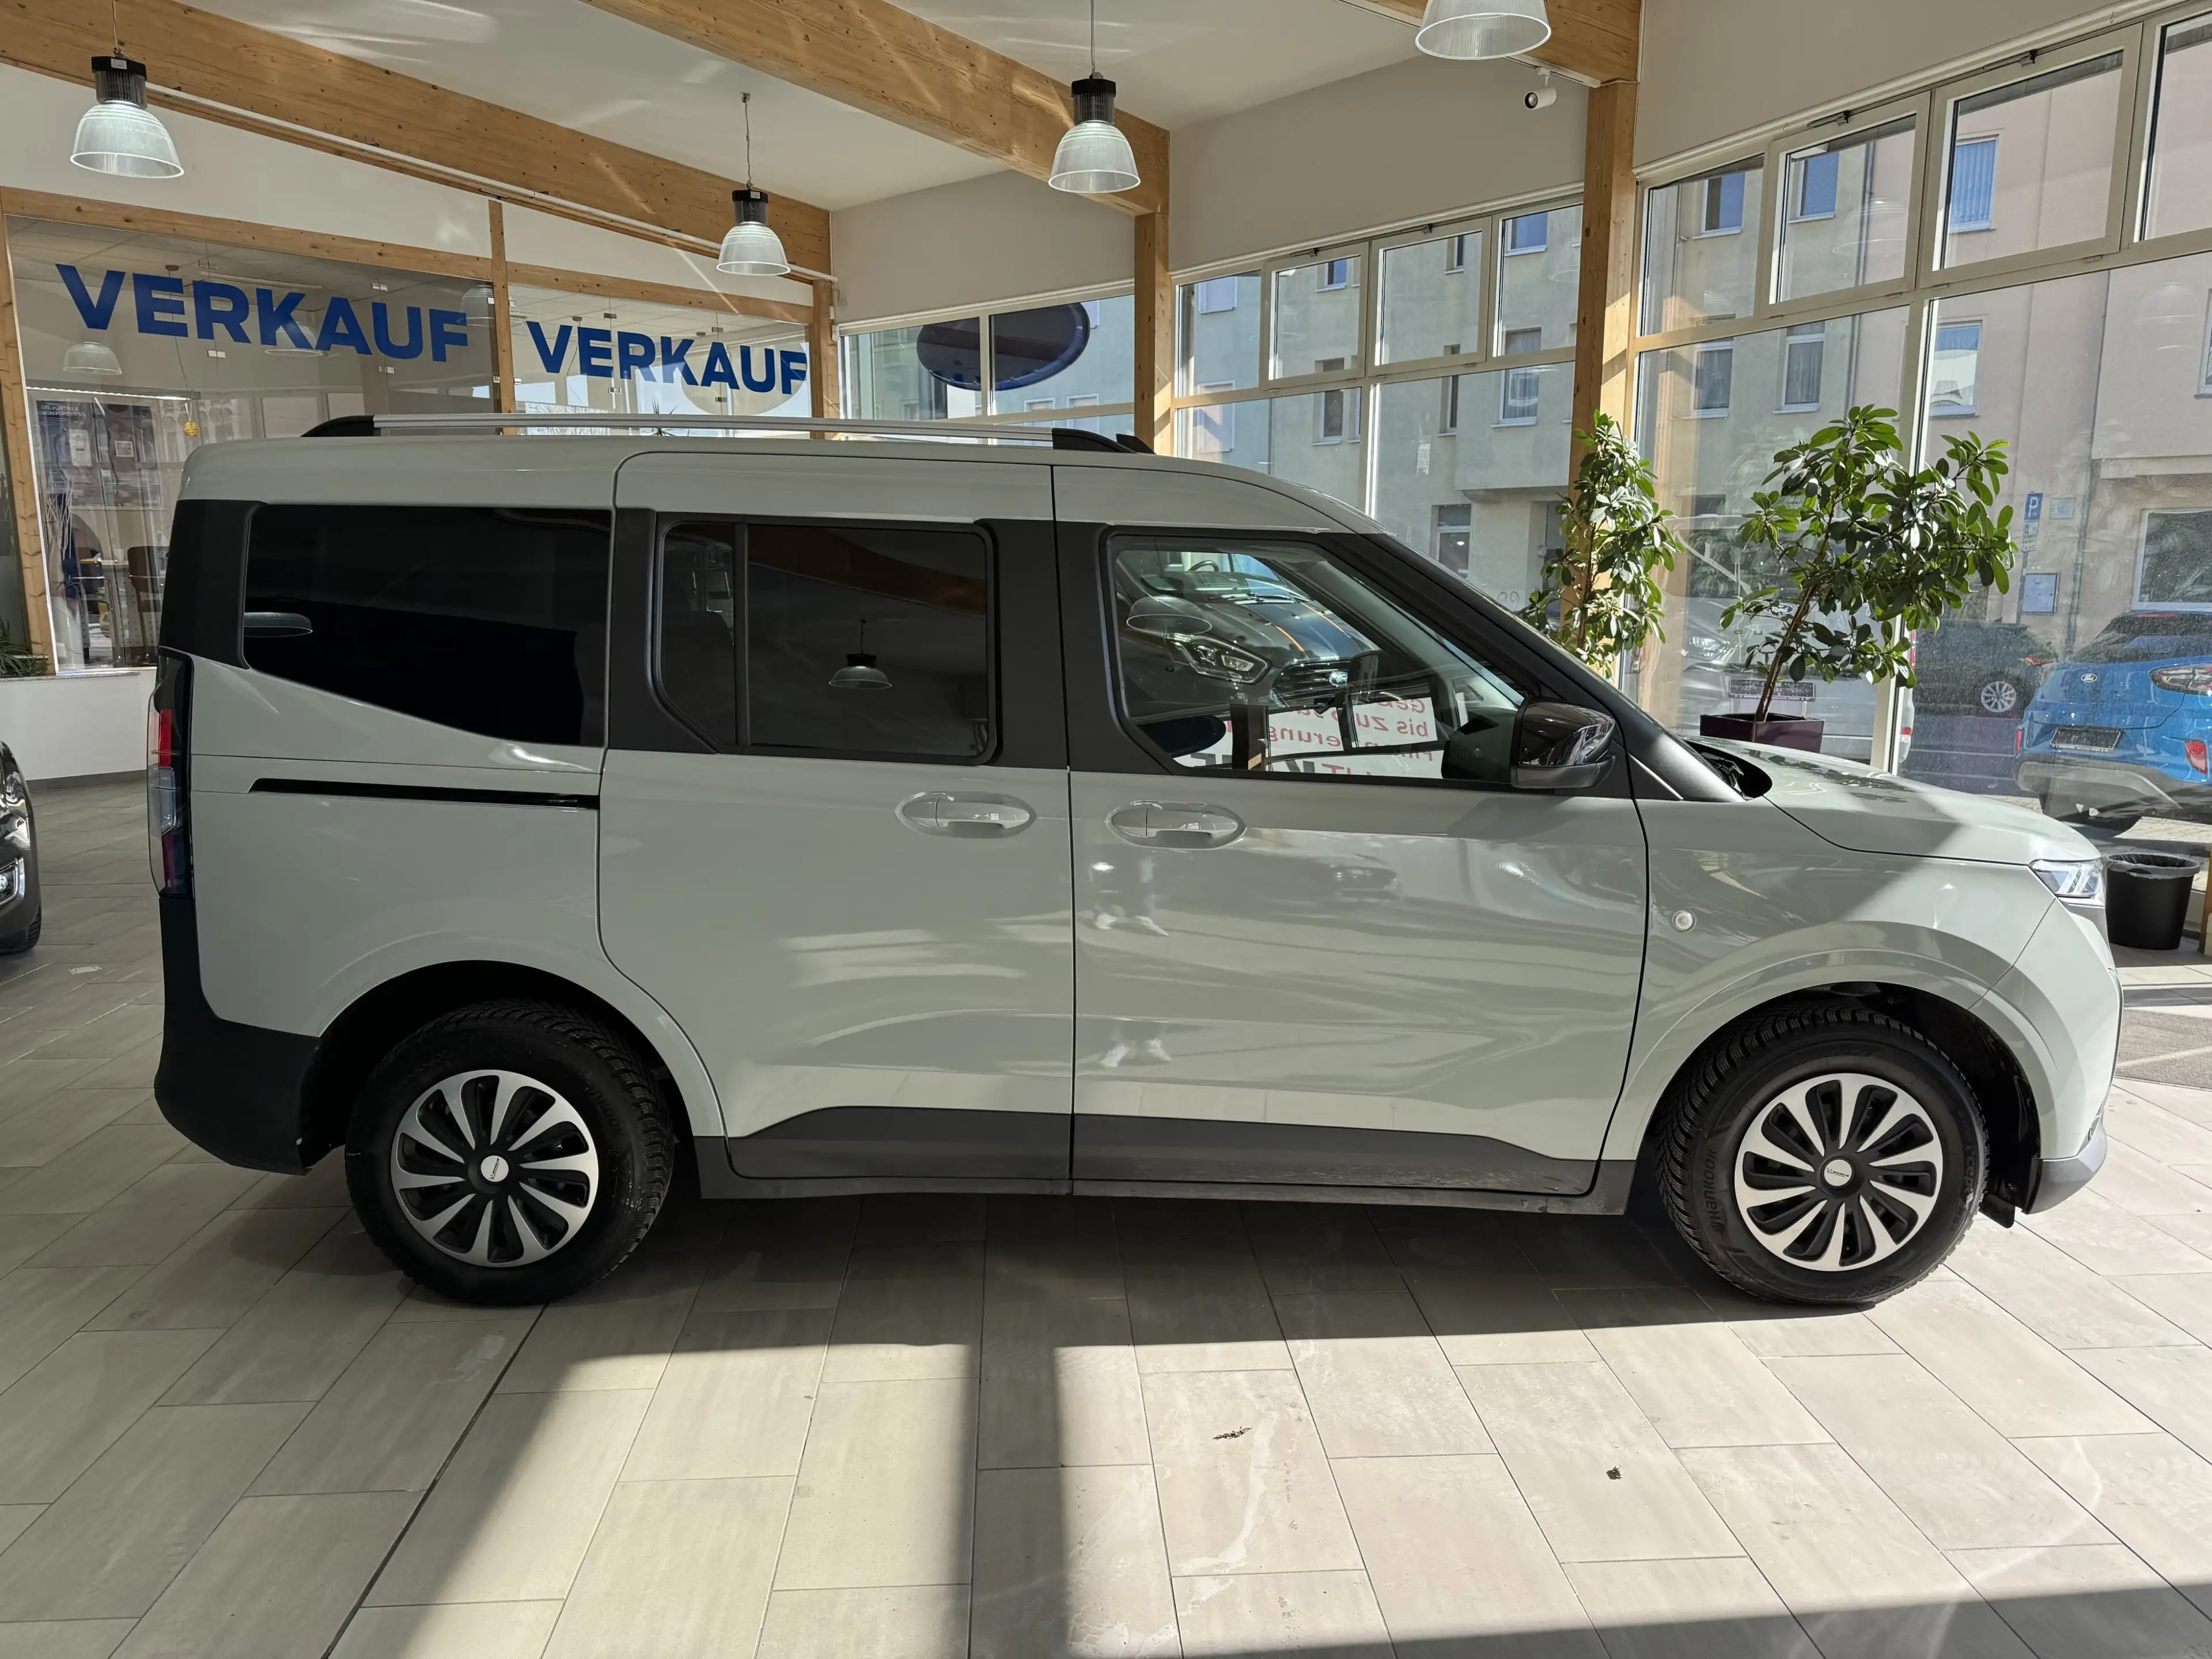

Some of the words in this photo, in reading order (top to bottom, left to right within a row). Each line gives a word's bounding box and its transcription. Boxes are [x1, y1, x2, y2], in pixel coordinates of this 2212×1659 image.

[55, 263, 468, 362] VERKAUF
[526, 321, 807, 395] VERKAUF
[2028, 497, 2039, 518] P
[1703, 1147, 1722, 1221] Hankook
